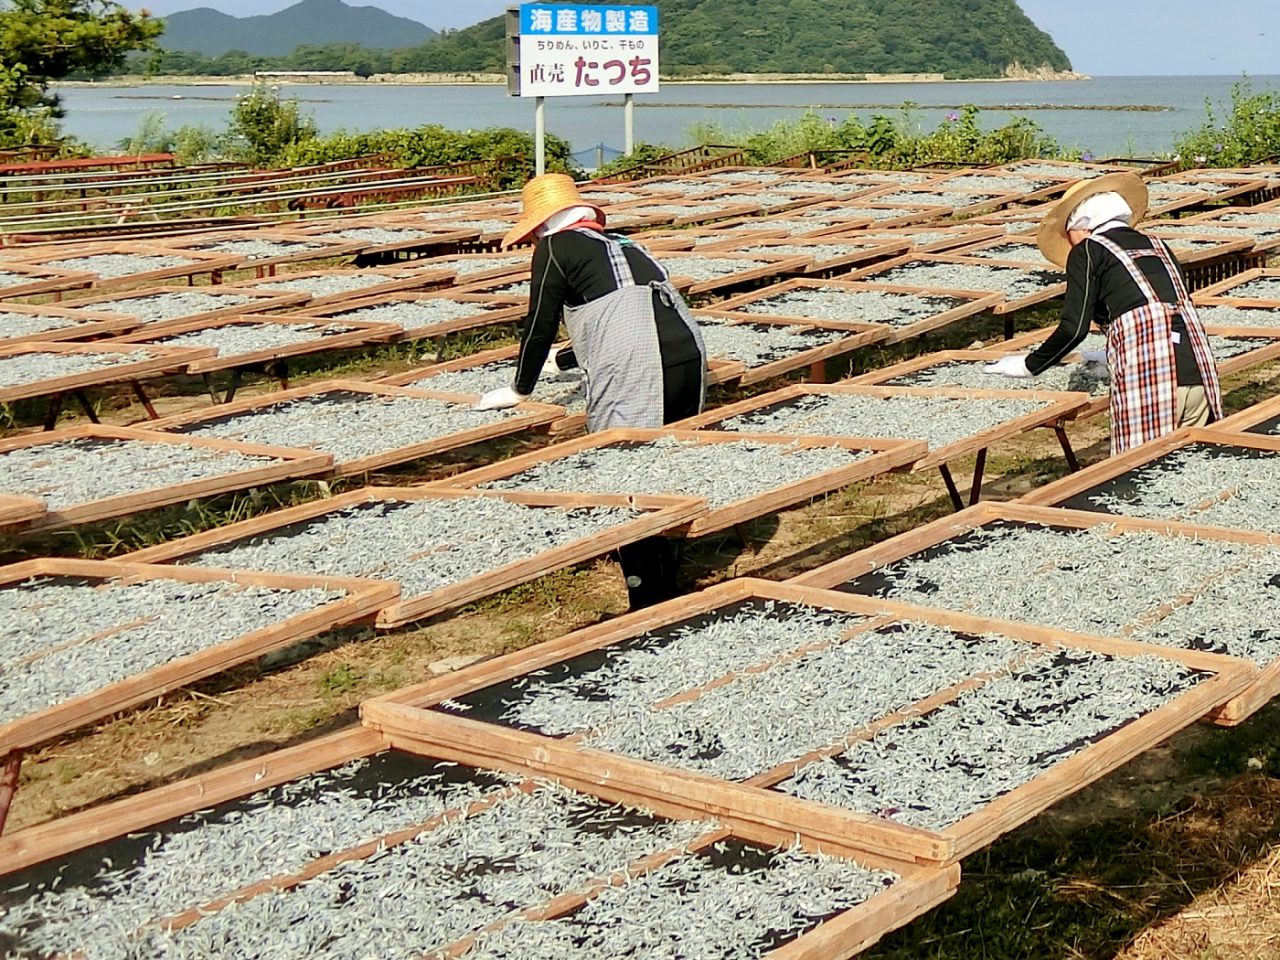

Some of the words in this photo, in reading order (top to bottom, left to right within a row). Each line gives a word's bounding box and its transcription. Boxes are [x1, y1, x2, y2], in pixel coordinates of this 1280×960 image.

[530, 8, 649, 32] 海産物製造
[530, 63, 564, 84] 直売
[574, 55, 651, 87] たつち
